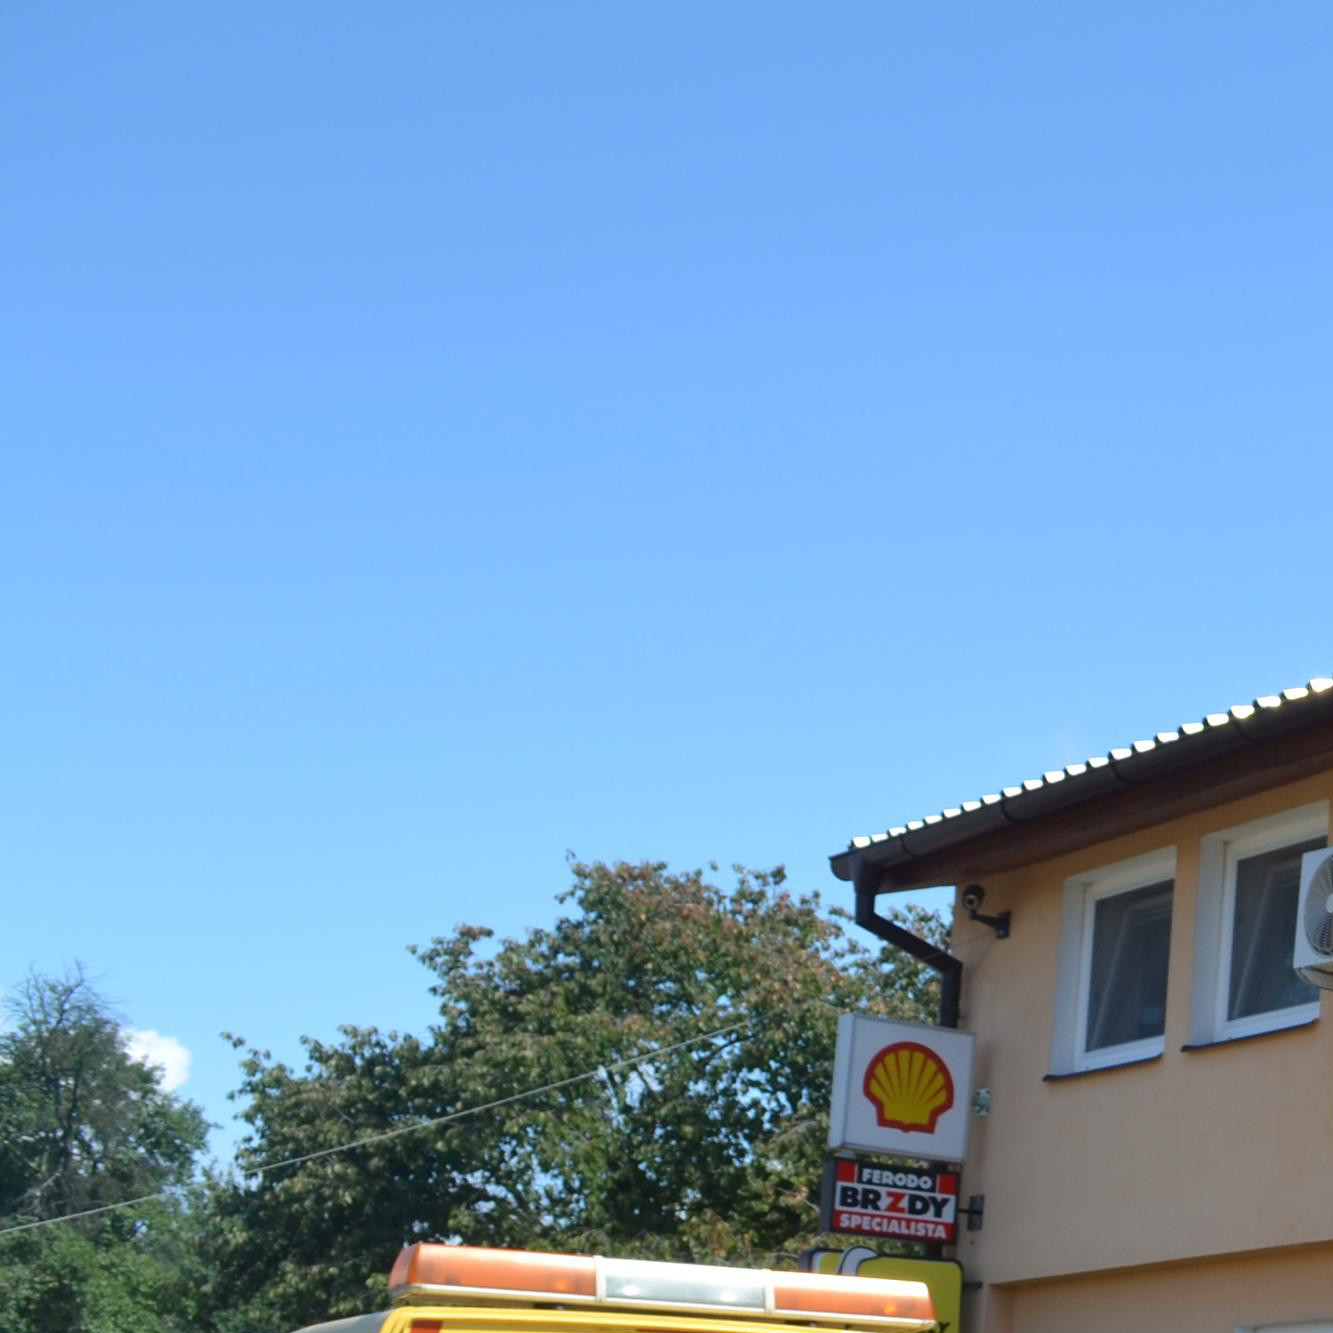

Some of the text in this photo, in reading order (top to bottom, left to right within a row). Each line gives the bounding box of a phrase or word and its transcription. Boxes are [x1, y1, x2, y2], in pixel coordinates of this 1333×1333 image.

[862, 1168, 933, 1190] FERODO
[840, 1185, 952, 1219] BRZDY
[839, 1213, 947, 1239] SPECIALISTA
